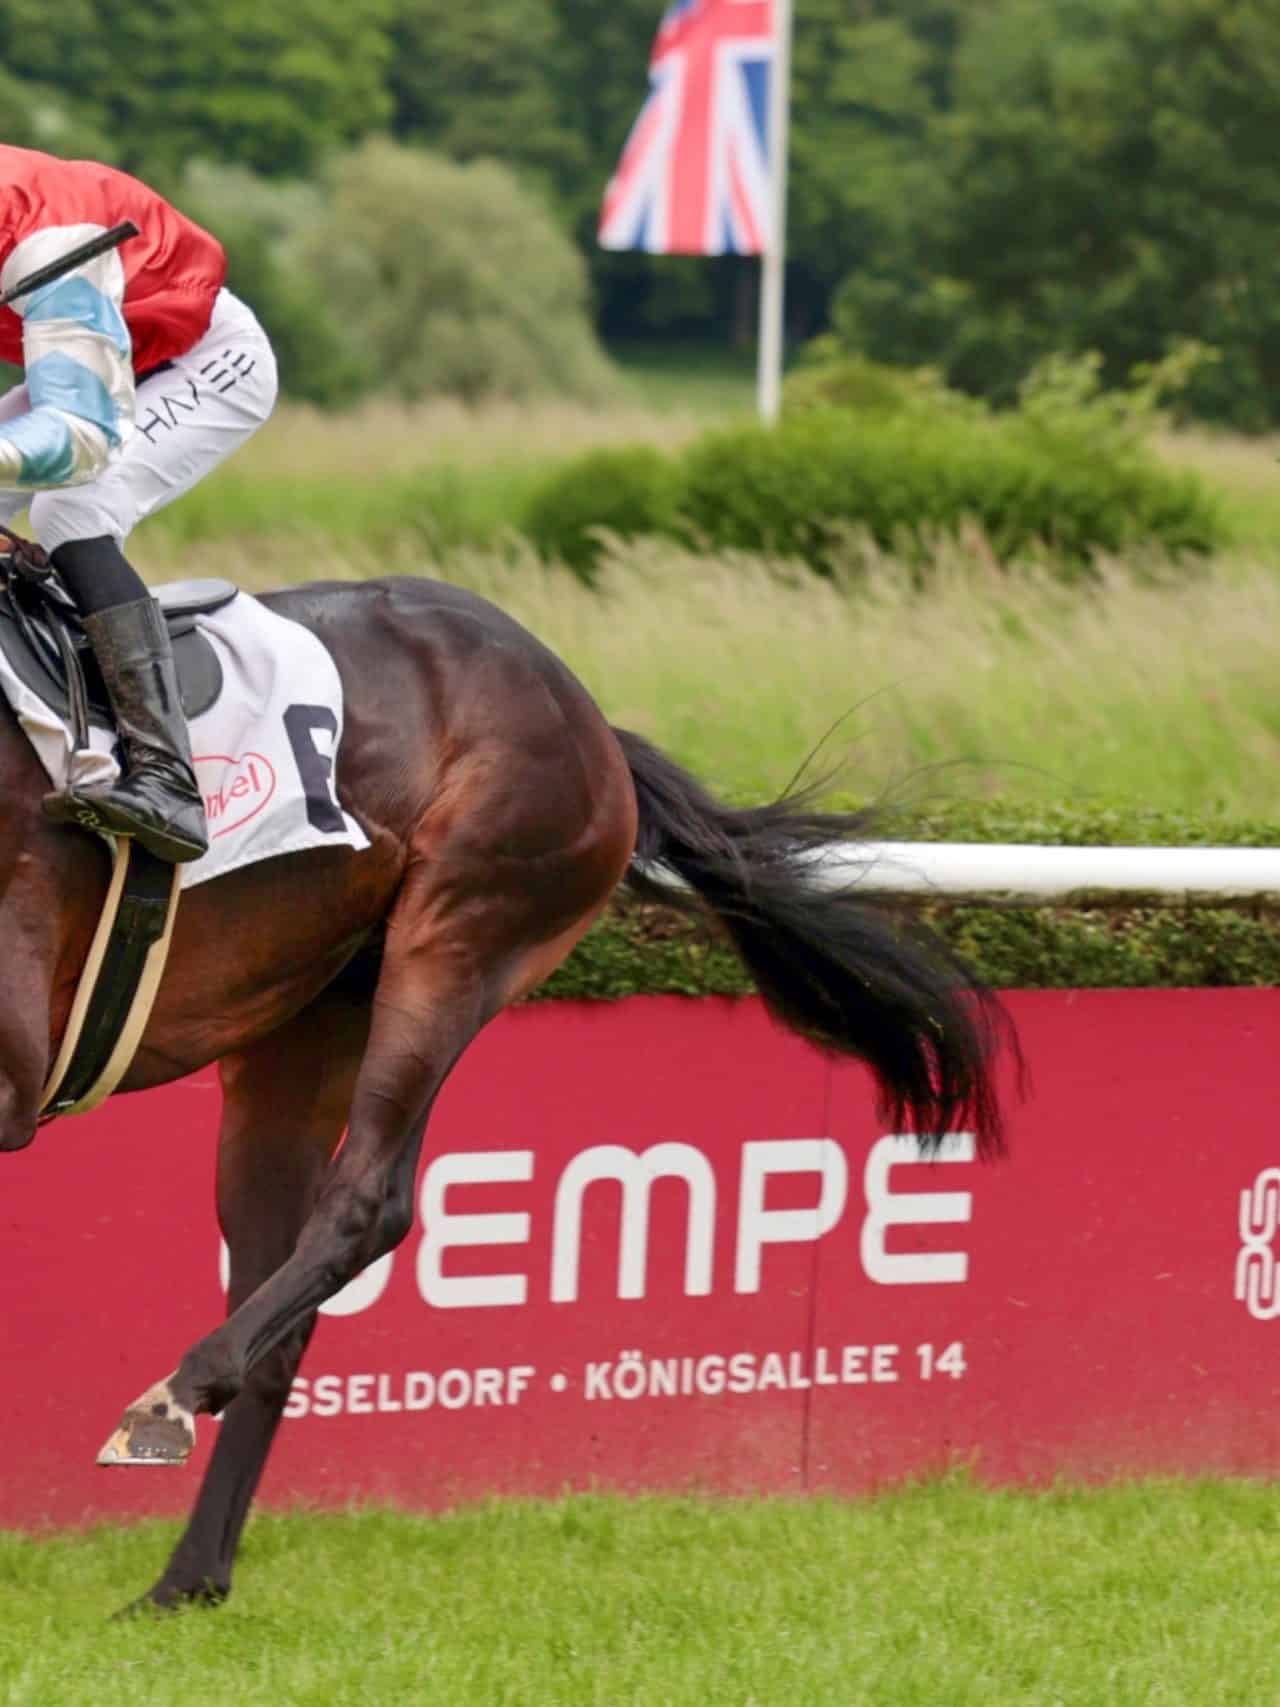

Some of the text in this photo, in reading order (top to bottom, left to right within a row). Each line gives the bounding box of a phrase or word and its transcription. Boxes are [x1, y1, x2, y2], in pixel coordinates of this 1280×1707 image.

[220, 1132, 976, 1316] EMPE
[214, 1341, 968, 1419] SSELDORF KÖNIGSALLEE 14
